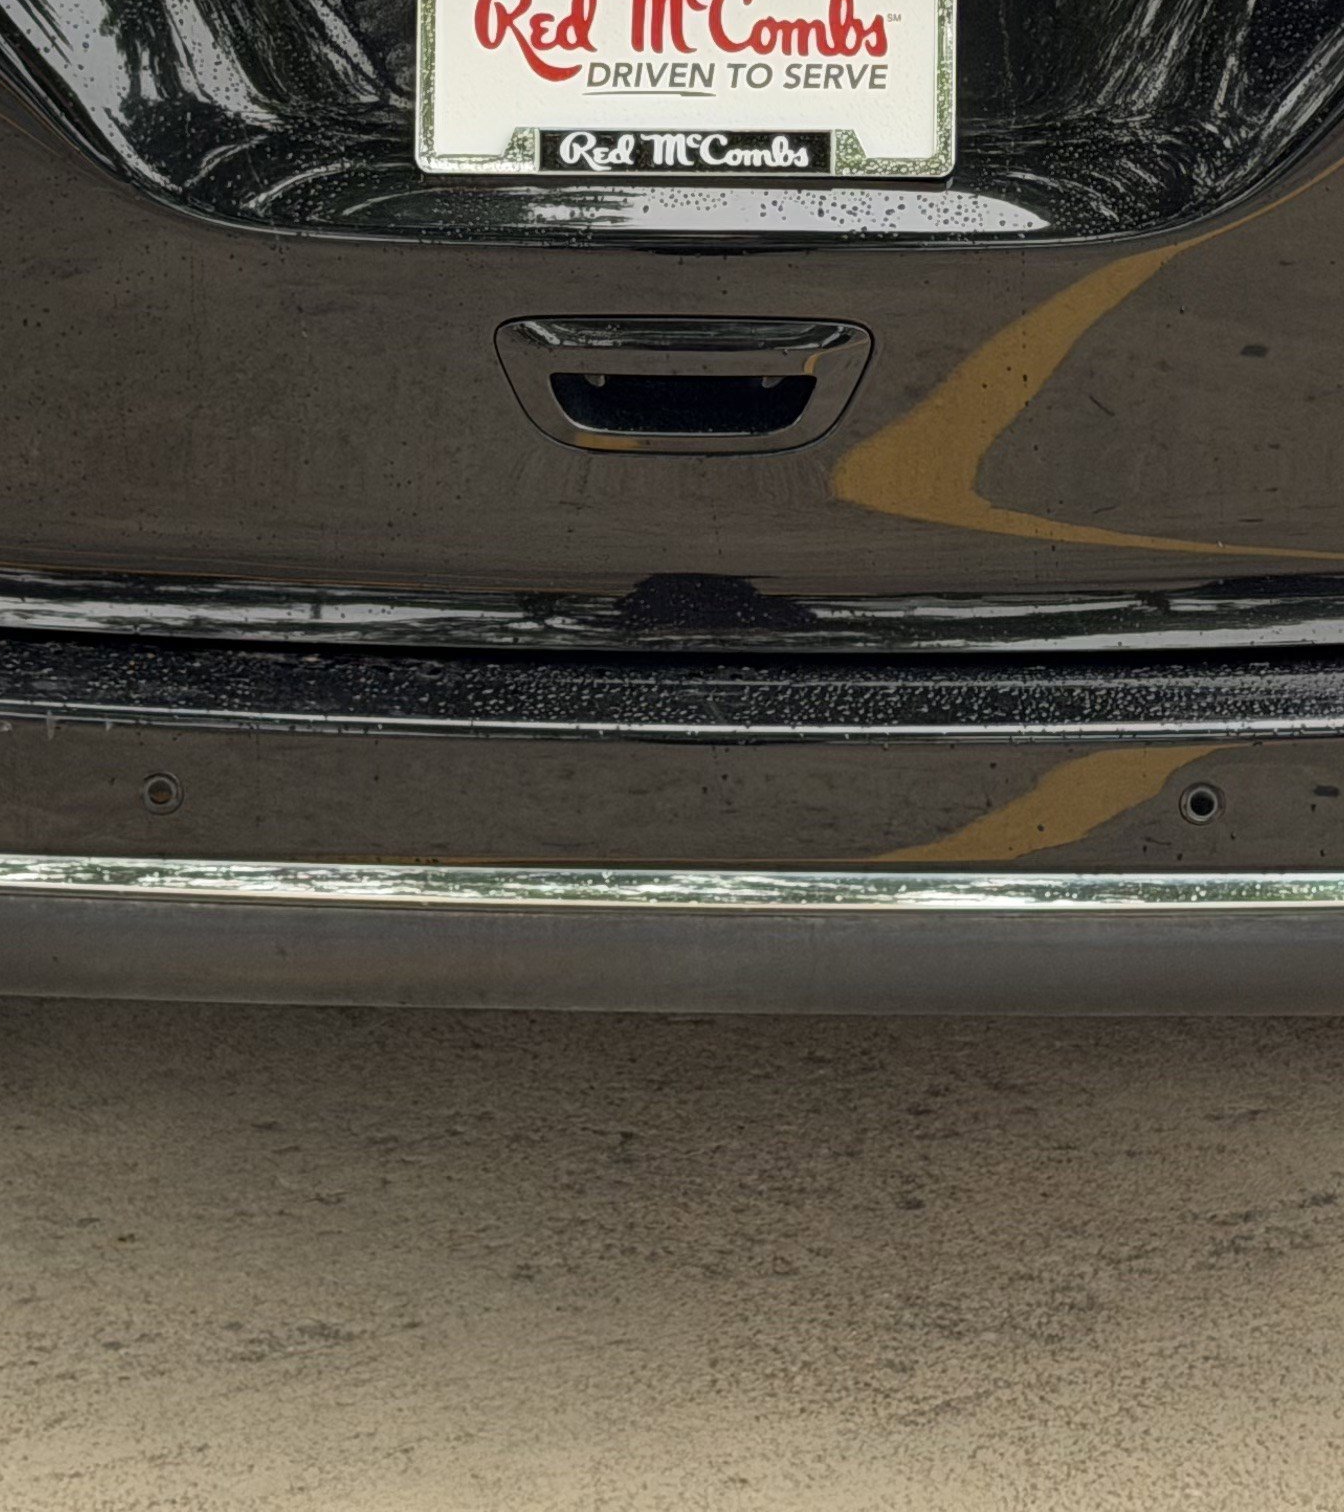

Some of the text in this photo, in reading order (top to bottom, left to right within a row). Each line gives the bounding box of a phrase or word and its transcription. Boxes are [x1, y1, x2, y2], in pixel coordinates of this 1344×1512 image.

[586, 61, 889, 91] DRIVEN TO SERVE
[559, 130, 810, 172] Red McCombs
